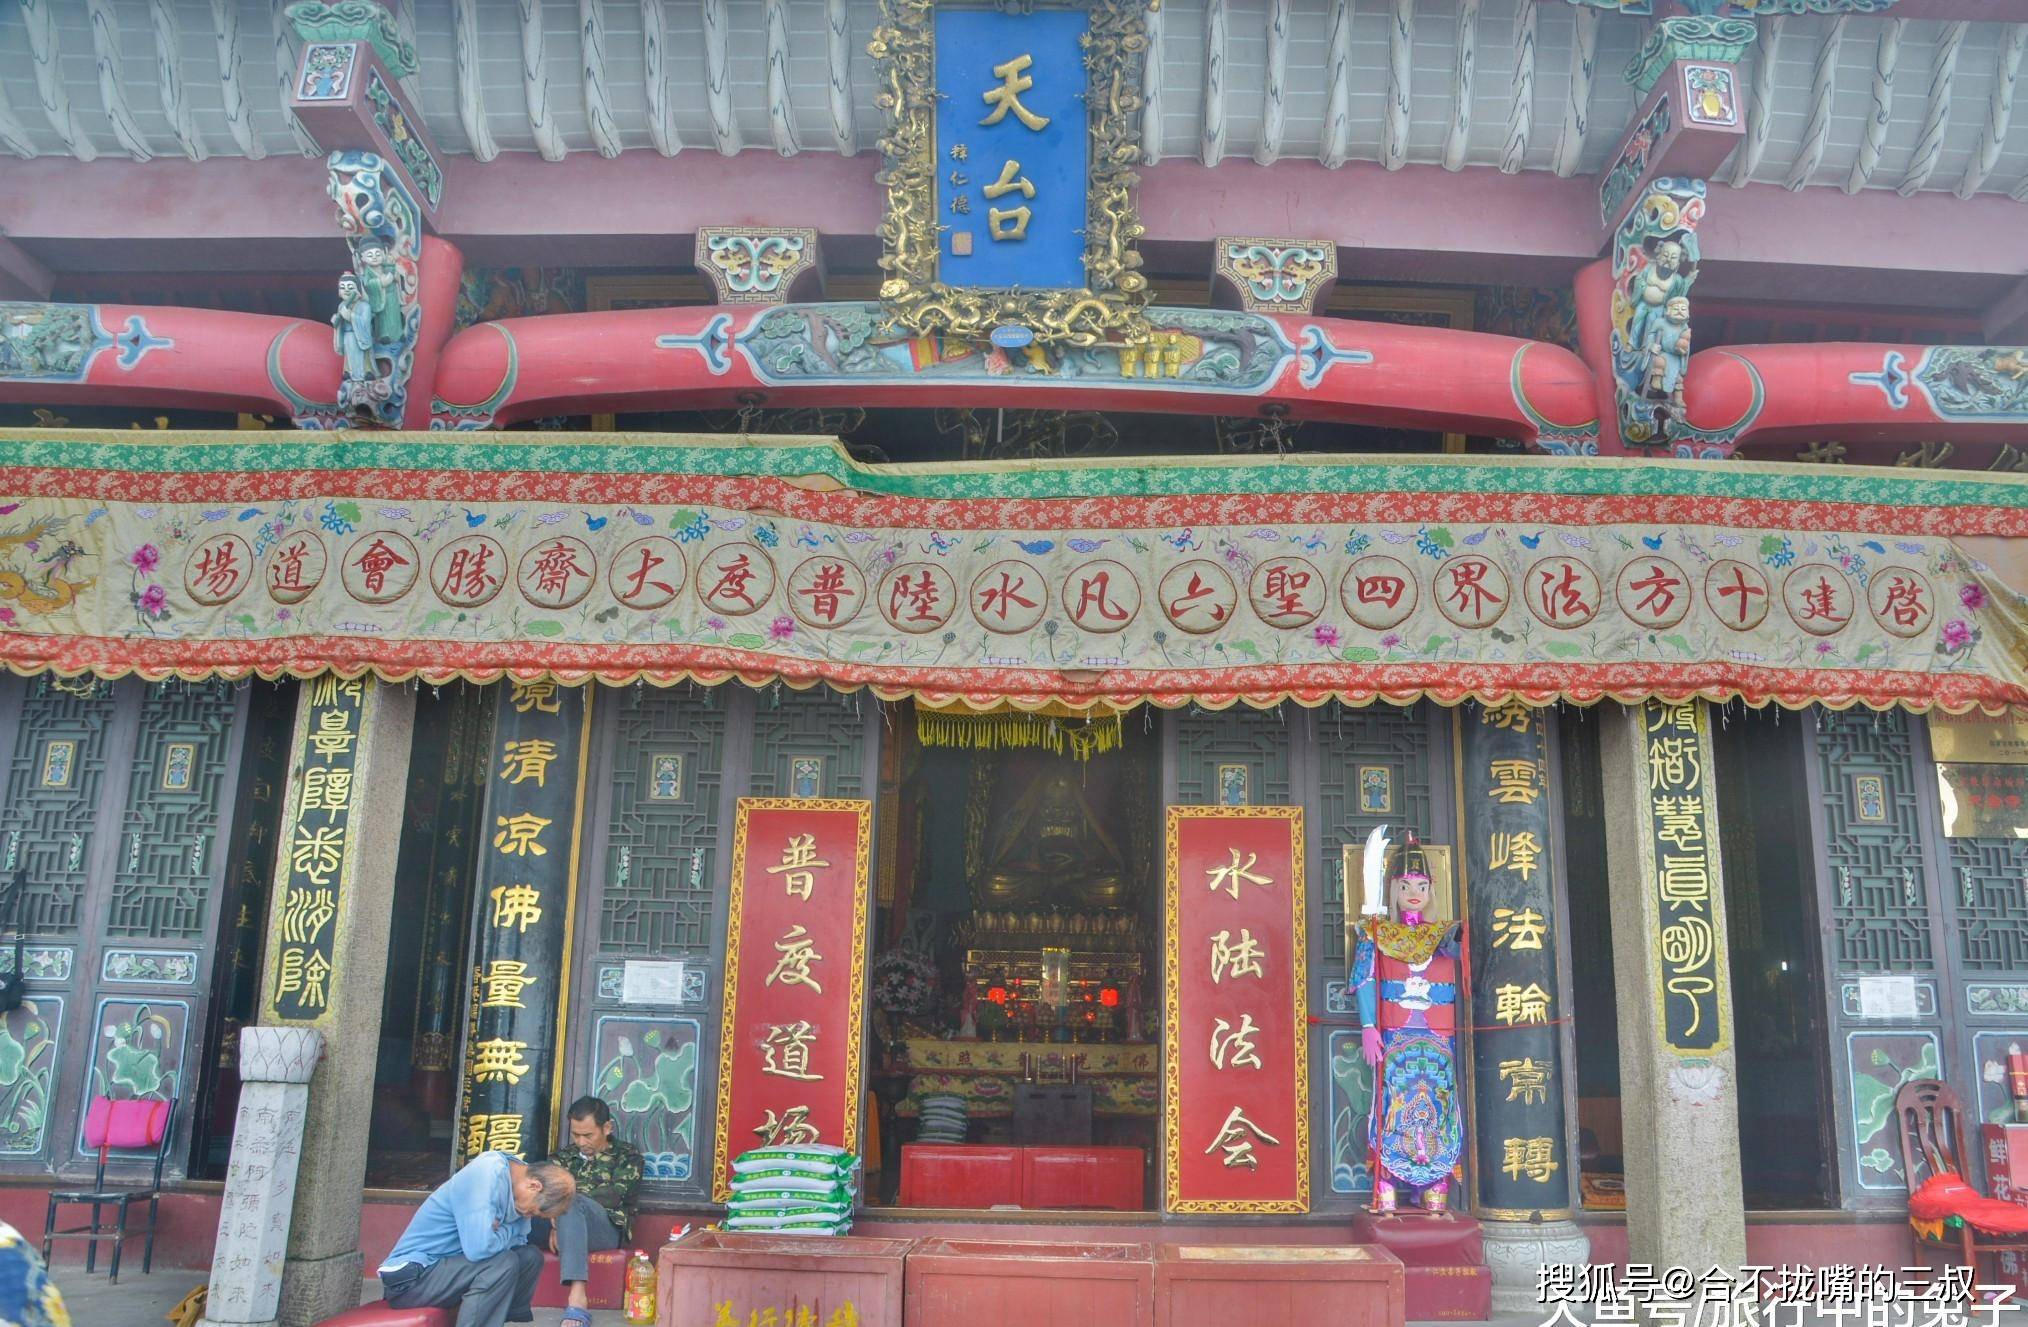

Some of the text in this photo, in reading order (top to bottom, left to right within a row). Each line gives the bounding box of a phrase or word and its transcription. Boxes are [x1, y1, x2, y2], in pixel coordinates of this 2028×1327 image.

[978, 54, 1051, 241] 天台
[752, 833, 830, 1146] 普度道场
[1205, 847, 1281, 1172] 水陆法会
